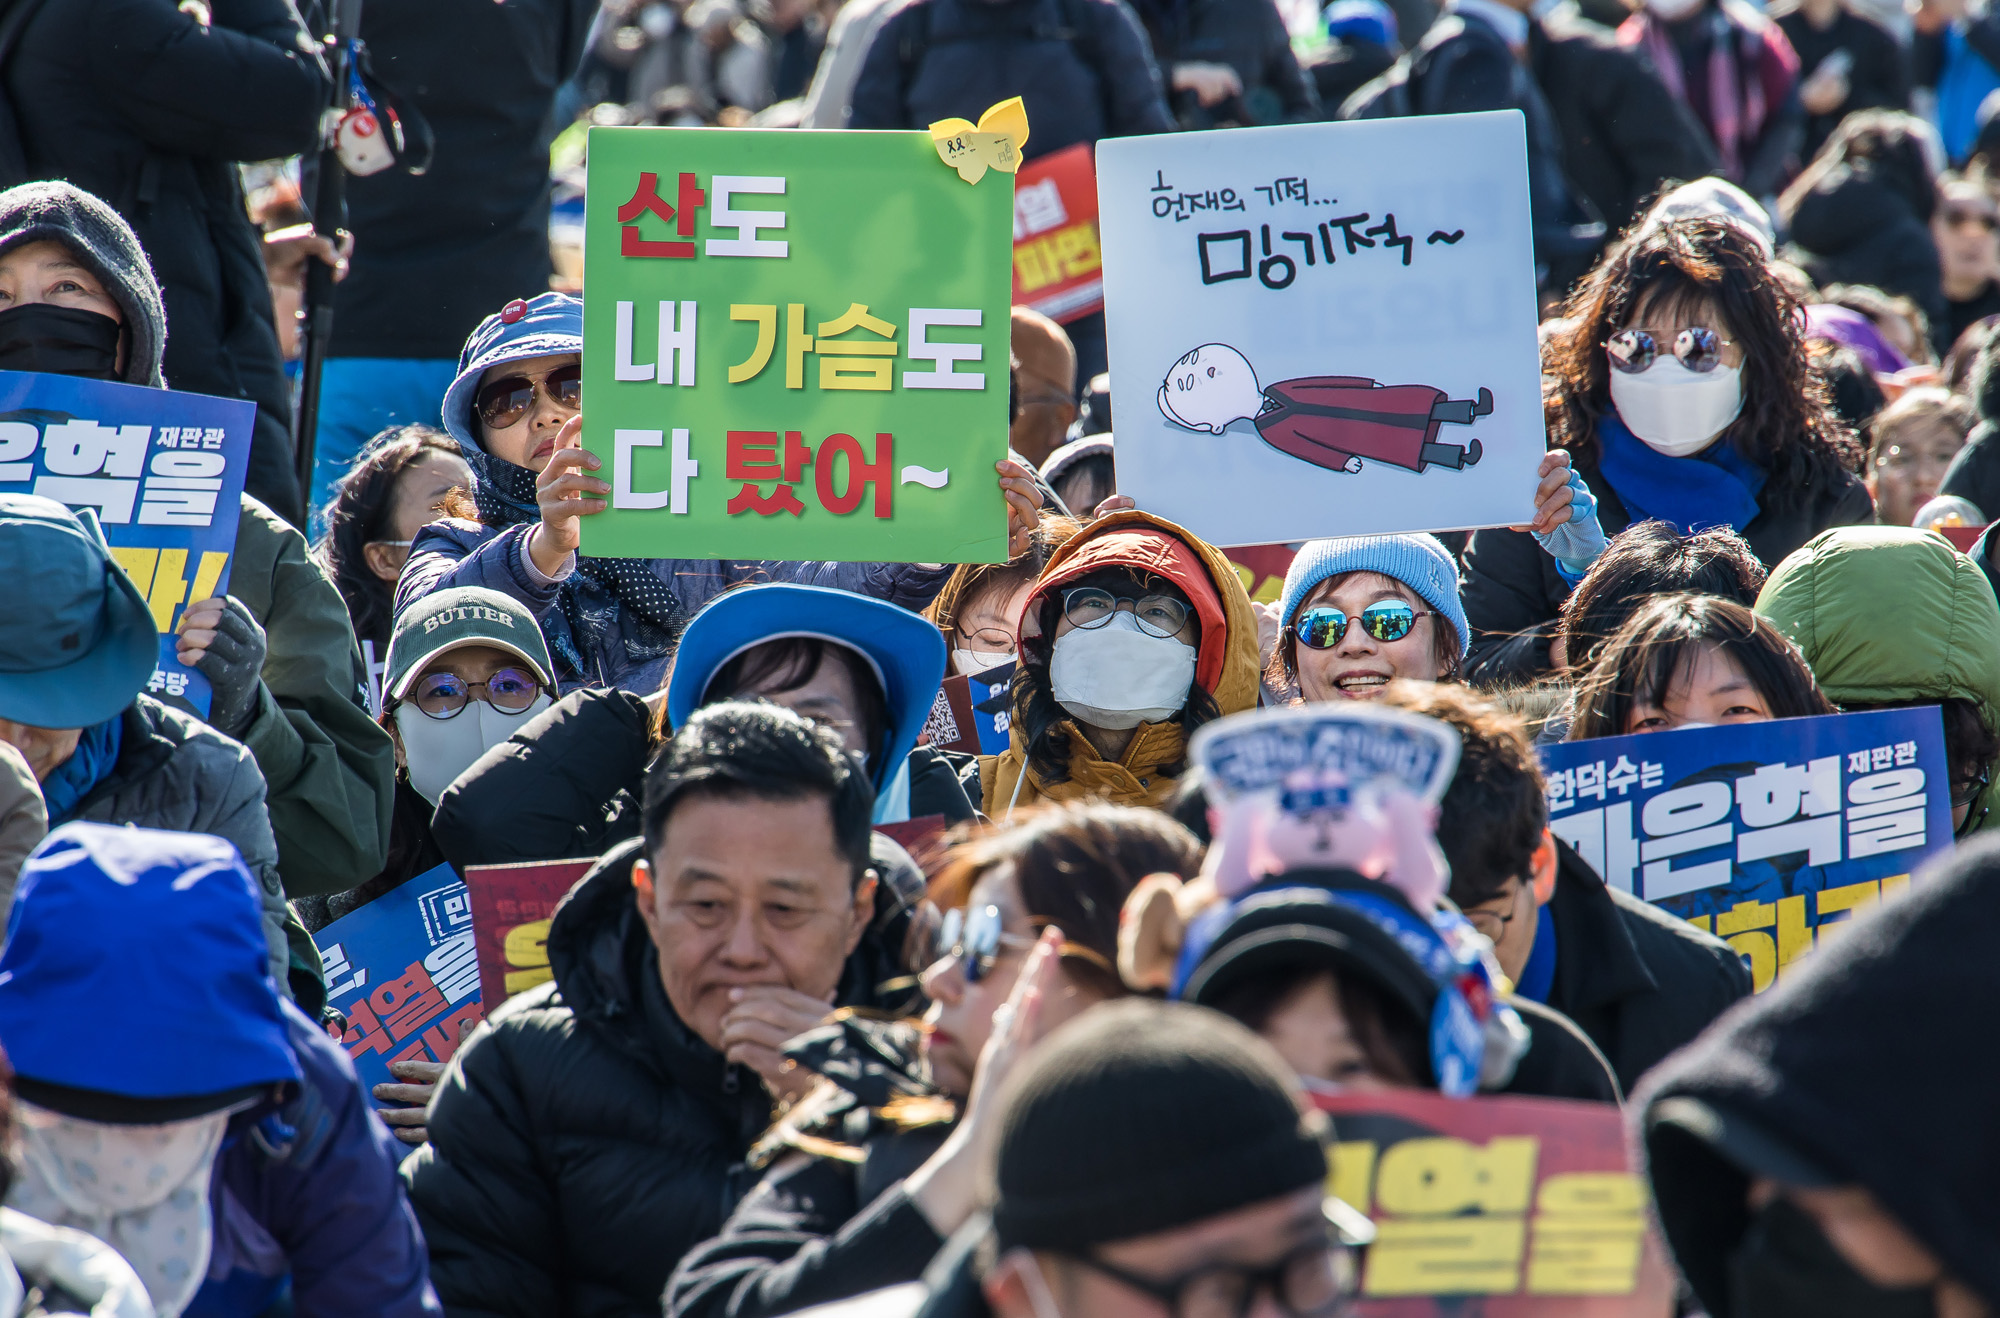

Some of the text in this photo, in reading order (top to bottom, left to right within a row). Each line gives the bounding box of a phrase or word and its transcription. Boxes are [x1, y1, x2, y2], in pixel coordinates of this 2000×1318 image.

[618, 172, 789, 258] 산도
[1151, 169, 1246, 222] 헌재의
[614, 301, 986, 391] 내 가슴도
[156, 426, 226, 449] 재판관
[613, 428, 949, 519] 다 탔어~
[422, 605, 515, 635] BUTTER
[146, 661, 190, 696] 주당
[1547, 754, 1665, 813] 한덕수는
[1847, 740, 1918, 774] 재판관
